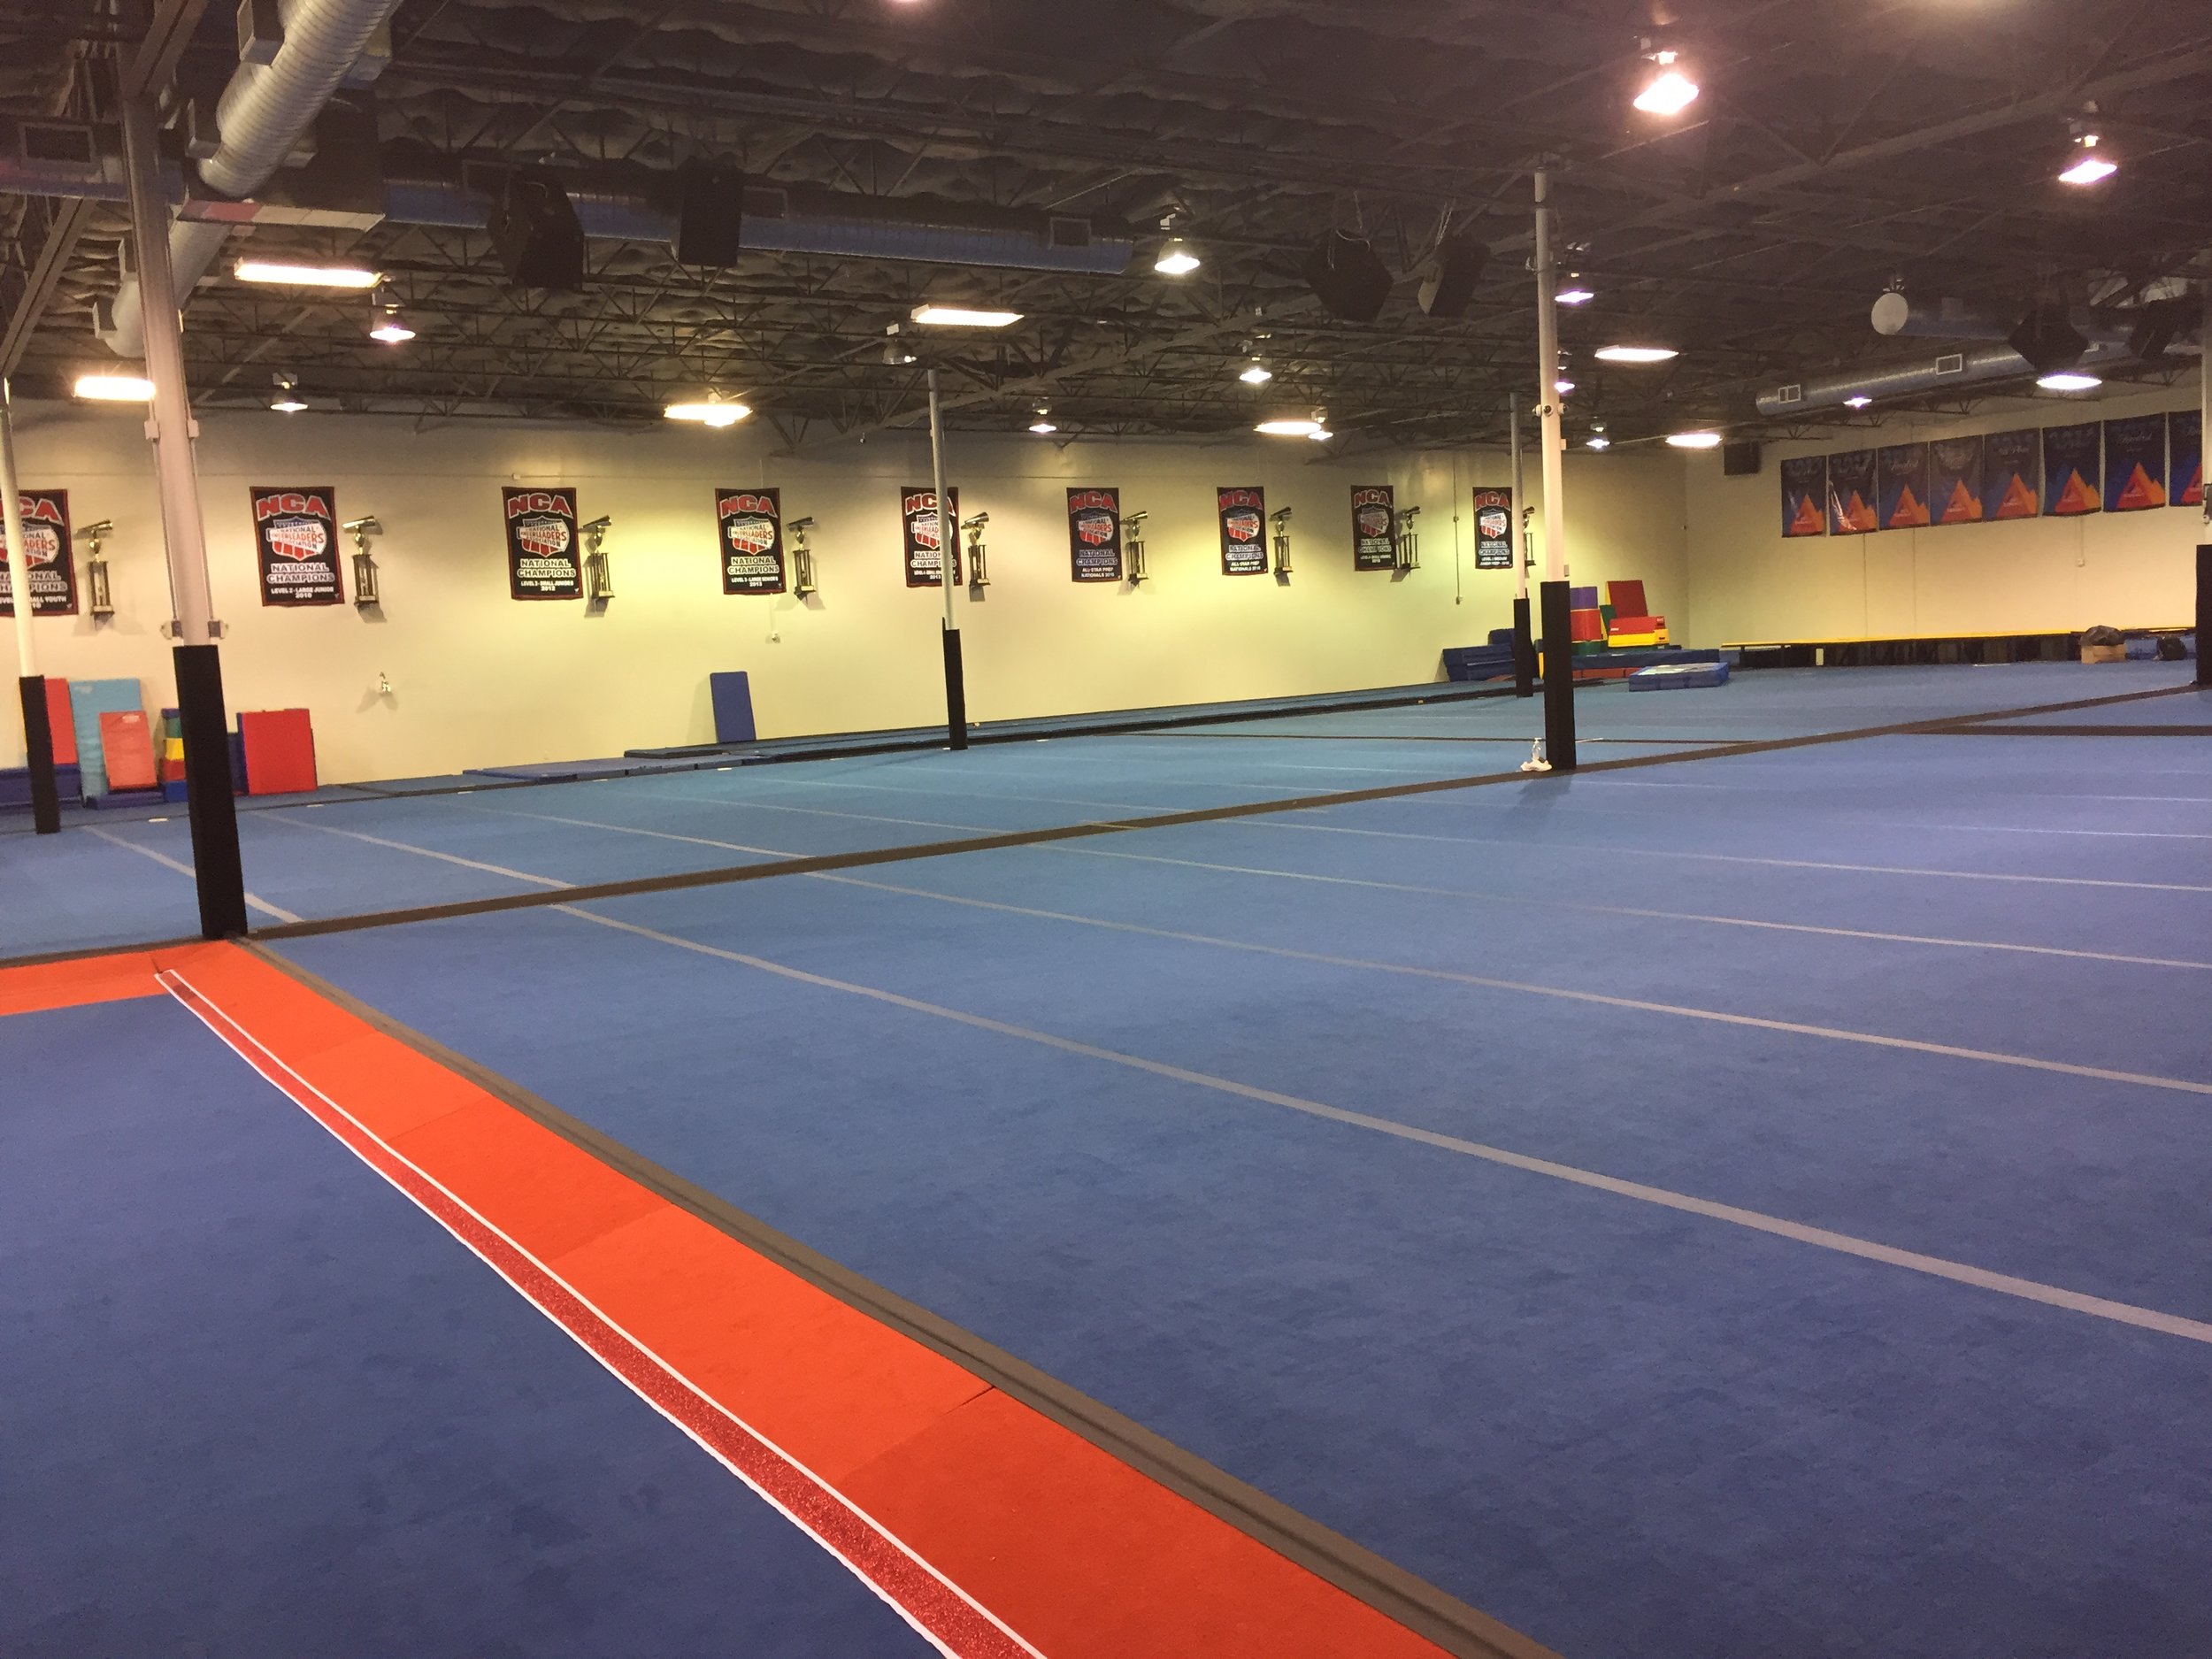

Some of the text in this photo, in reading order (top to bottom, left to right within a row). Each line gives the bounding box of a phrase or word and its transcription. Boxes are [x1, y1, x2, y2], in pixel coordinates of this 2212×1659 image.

[1070, 490, 1118, 514] NCA
[1219, 489, 1263, 512] NCA
[1355, 488, 1393, 509] NCA
[1475, 490, 1511, 512] NCA
[0, 495, 65, 526] CA
[256, 493, 332, 522] NCA
[508, 492, 574, 519] NCA
[719, 494, 778, 519] NCA
[280, 525, 316, 534] NATIONAL
[528, 524, 560, 533] NATIONAL
[914, 550, 942, 559] NATIO
[1079, 549, 1116, 557] NATIONAL
[520, 558, 572, 568] NATIONAL
[731, 556, 777, 565] NATIONAL
[1075, 557, 1118, 566] CHAMPIONS
[271, 562, 330, 573] NATIONAL
[517, 567, 577, 578] CHAMPIONS
[726, 565, 780, 575] CHAMPIONS
[266, 572, 335, 584] CHAMPIONS
